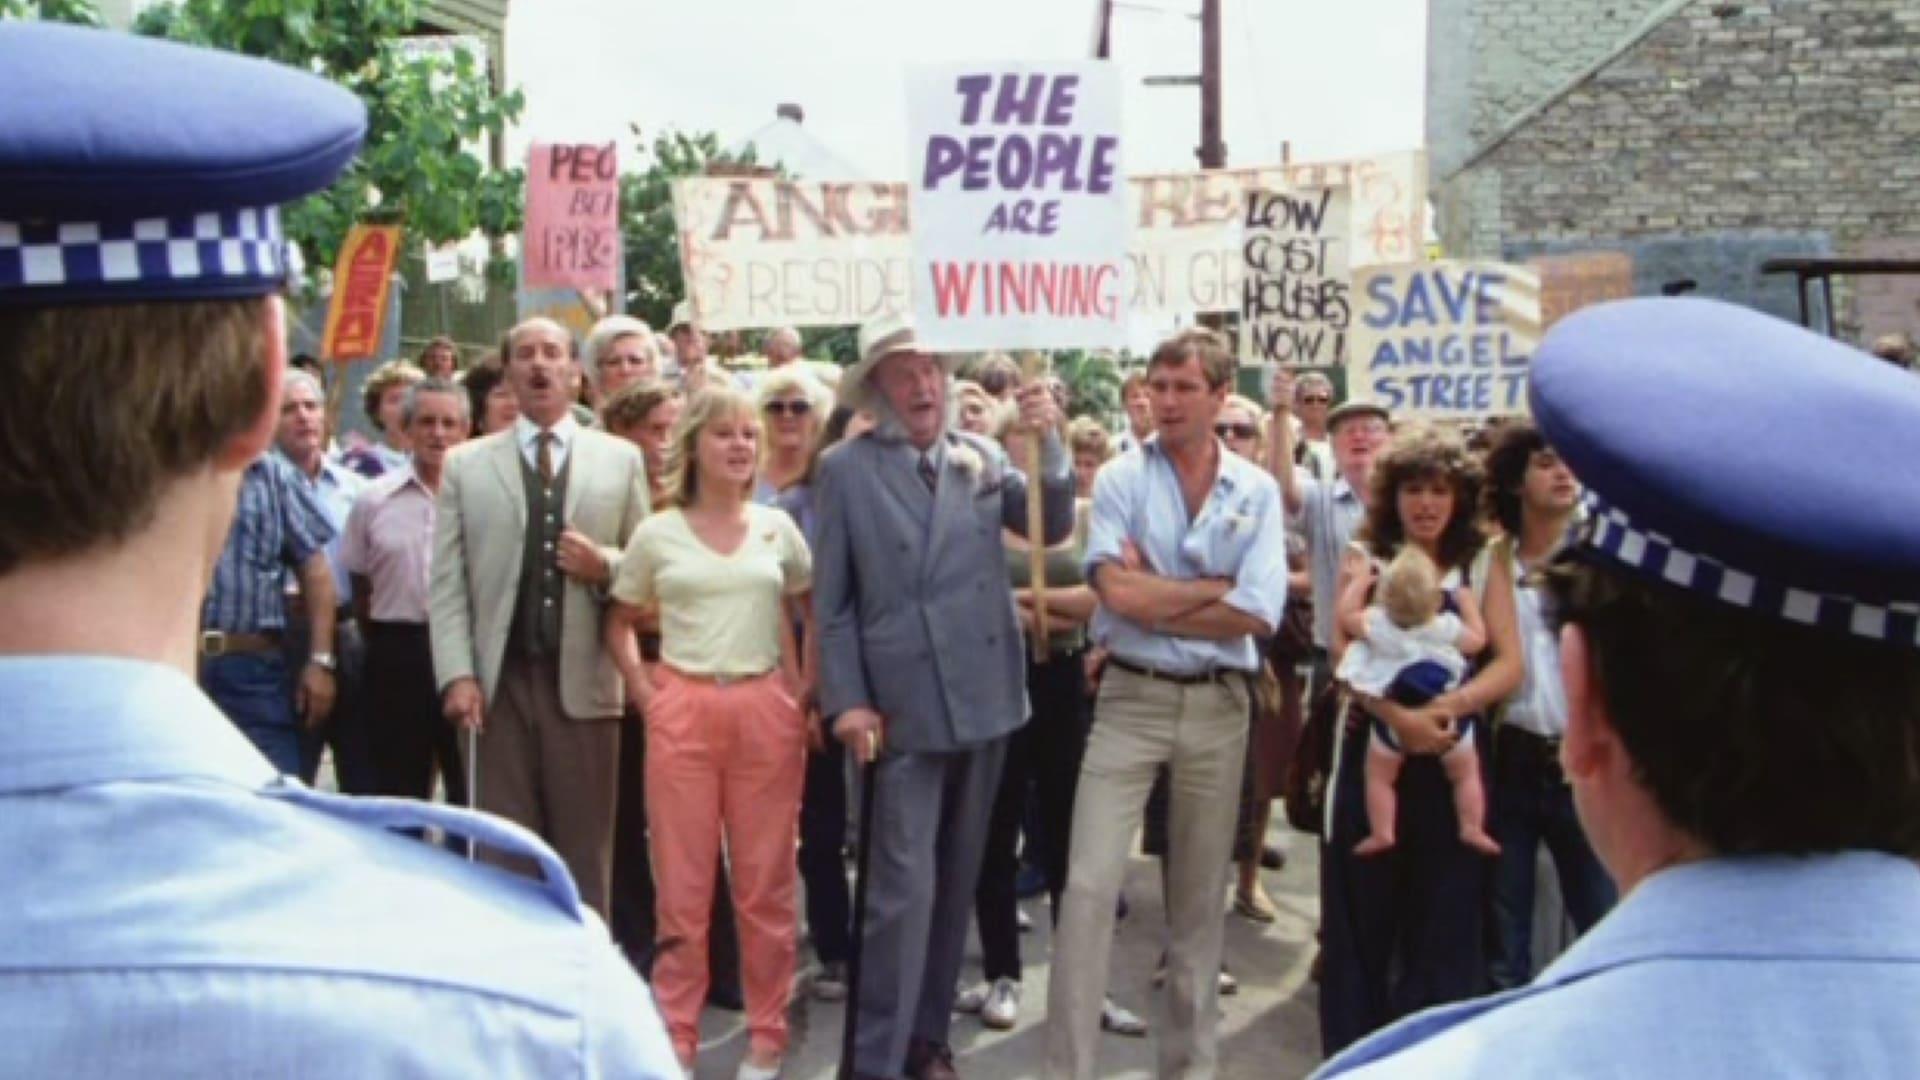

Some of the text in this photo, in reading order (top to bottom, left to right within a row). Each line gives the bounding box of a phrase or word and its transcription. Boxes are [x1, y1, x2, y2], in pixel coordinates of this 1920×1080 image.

[956, 73, 1079, 126] THE
[922, 133, 1118, 194] PEOPLE
[981, 198, 1060, 236] ARE
[1245, 187, 1331, 234] LOW
[1244, 234, 1340, 277] COST
[930, 260, 1119, 320] WINNING
[1241, 275, 1350, 330] HOUSES
[1362, 269, 1508, 329] SAVE
[1370, 332, 1529, 370] ANGEL
[1373, 373, 1529, 410] STREET
